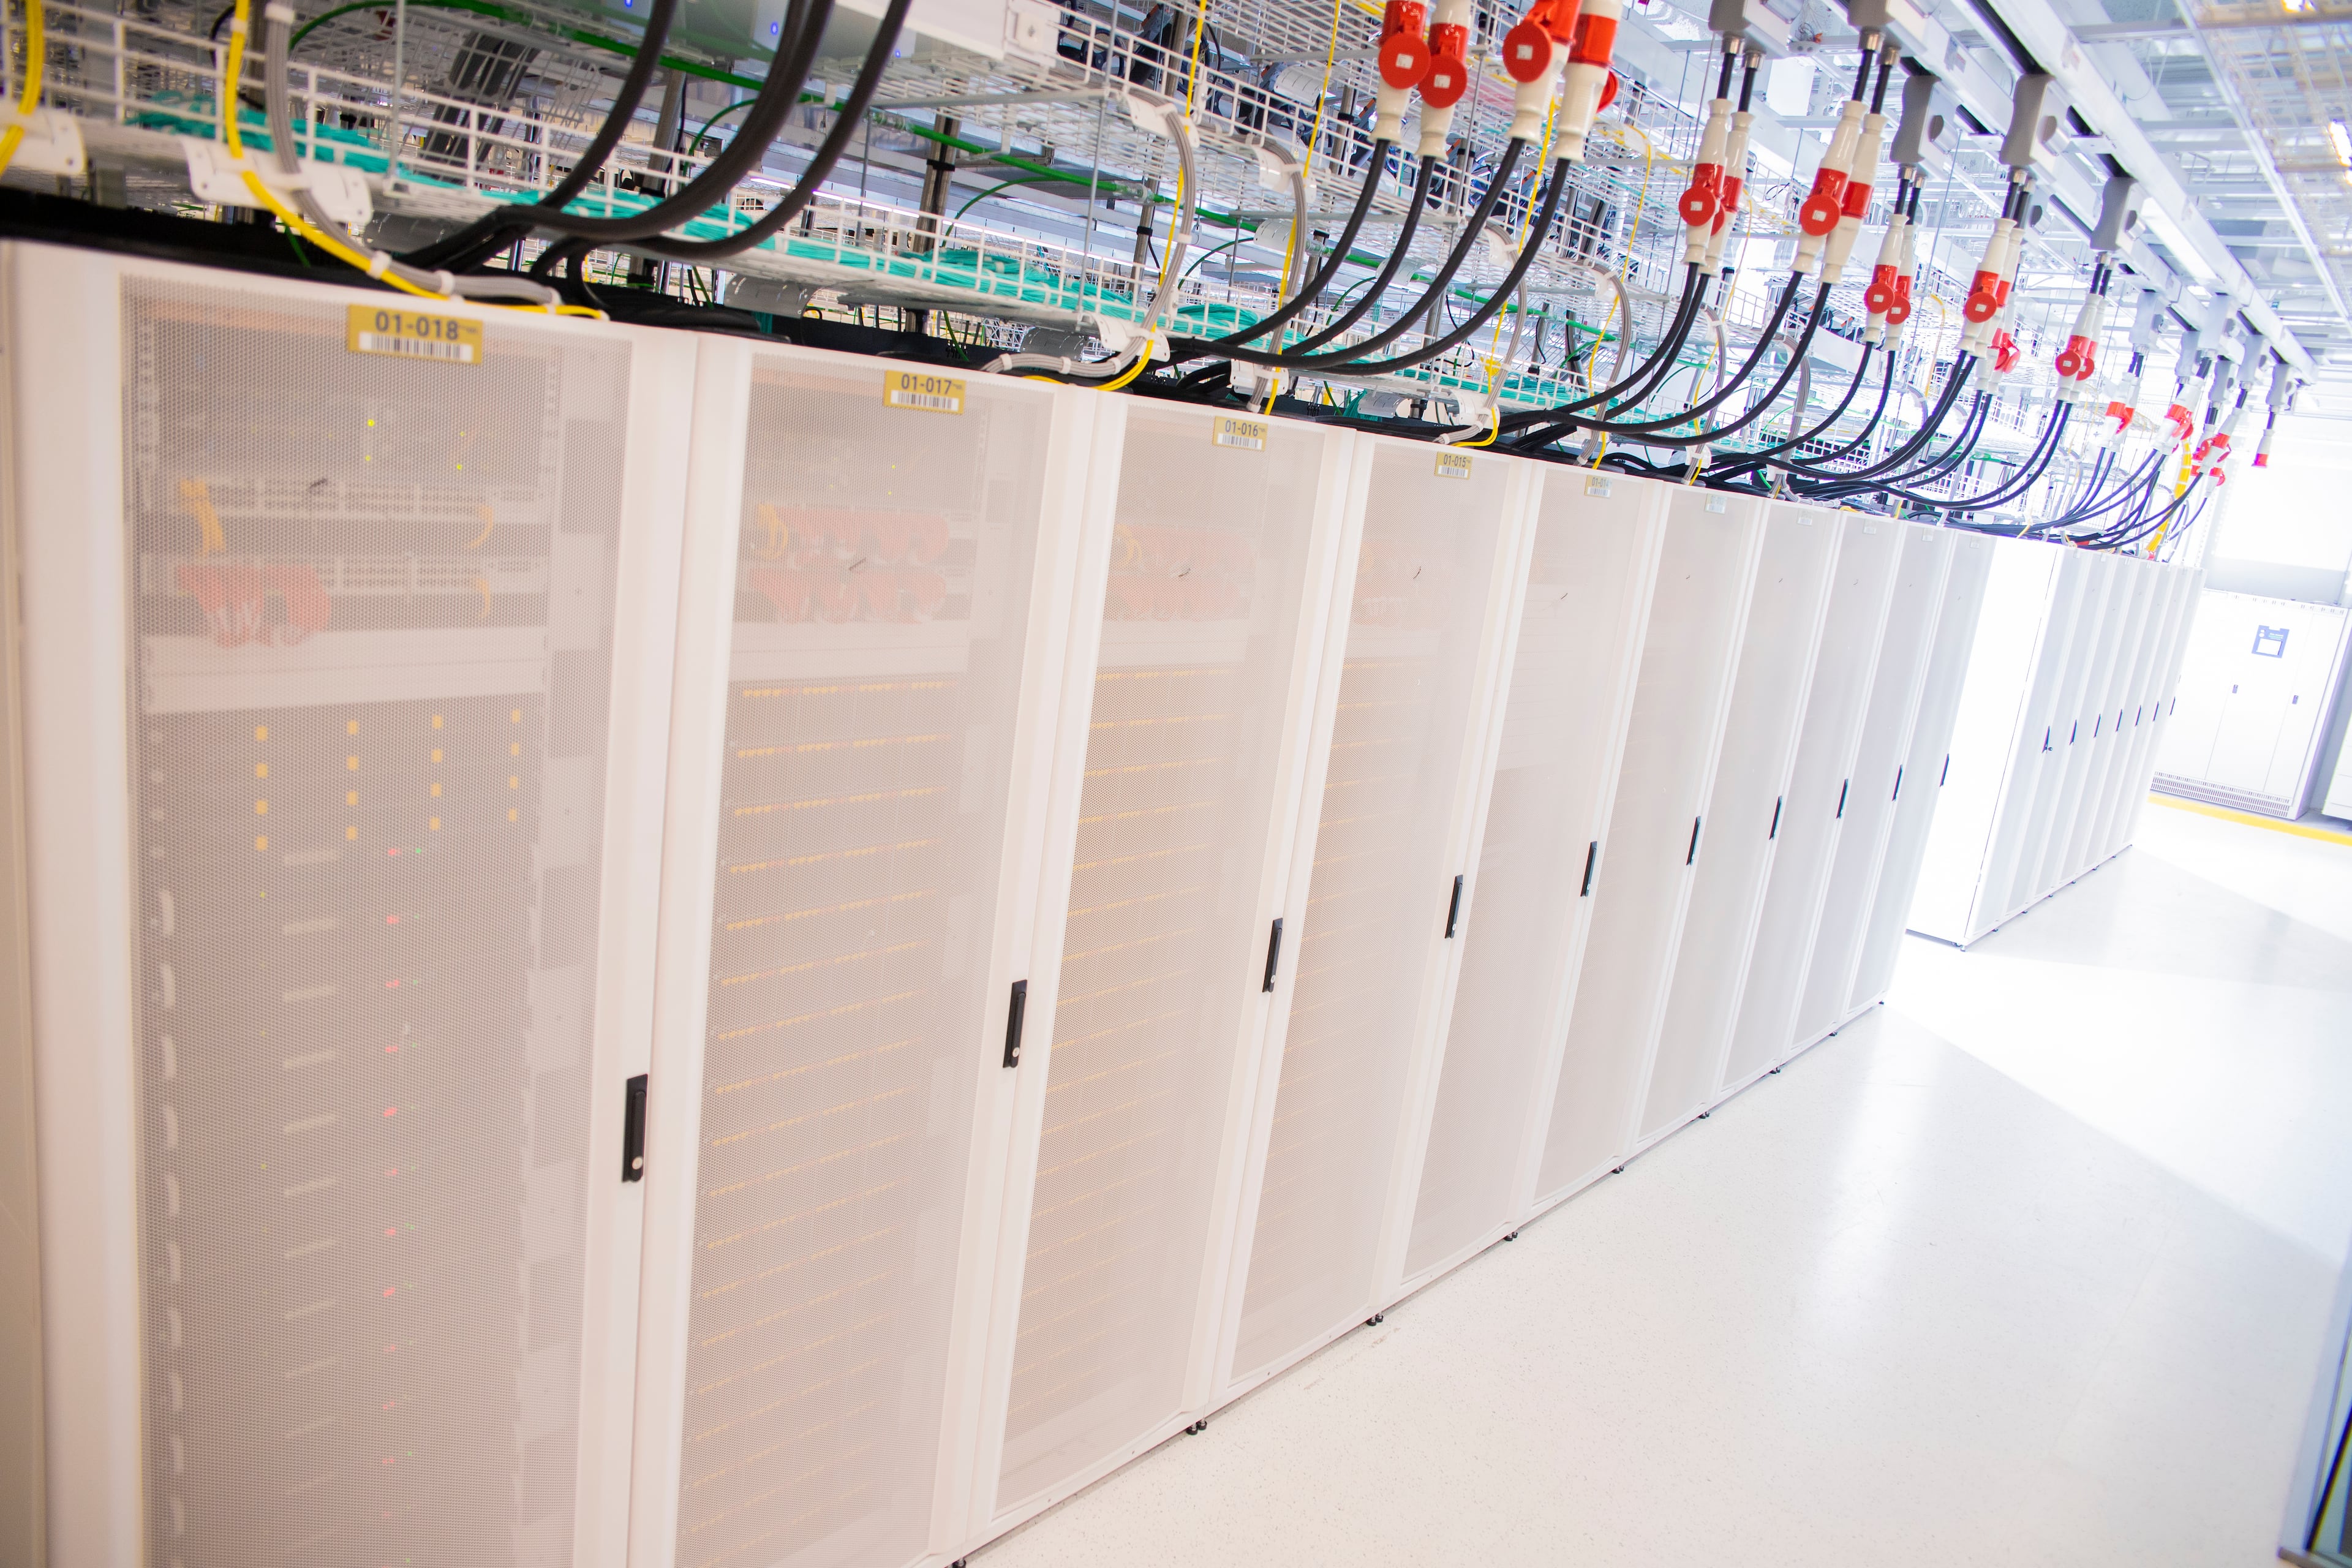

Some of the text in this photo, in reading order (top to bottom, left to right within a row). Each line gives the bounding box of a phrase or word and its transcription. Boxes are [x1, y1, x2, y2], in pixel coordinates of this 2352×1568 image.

[375, 311, 459, 341] 01-018
[902, 373, 952, 395] 01-017
[1225, 420, 1258, 437] 01-016
[1444, 454, 1466, 468] 01-015
